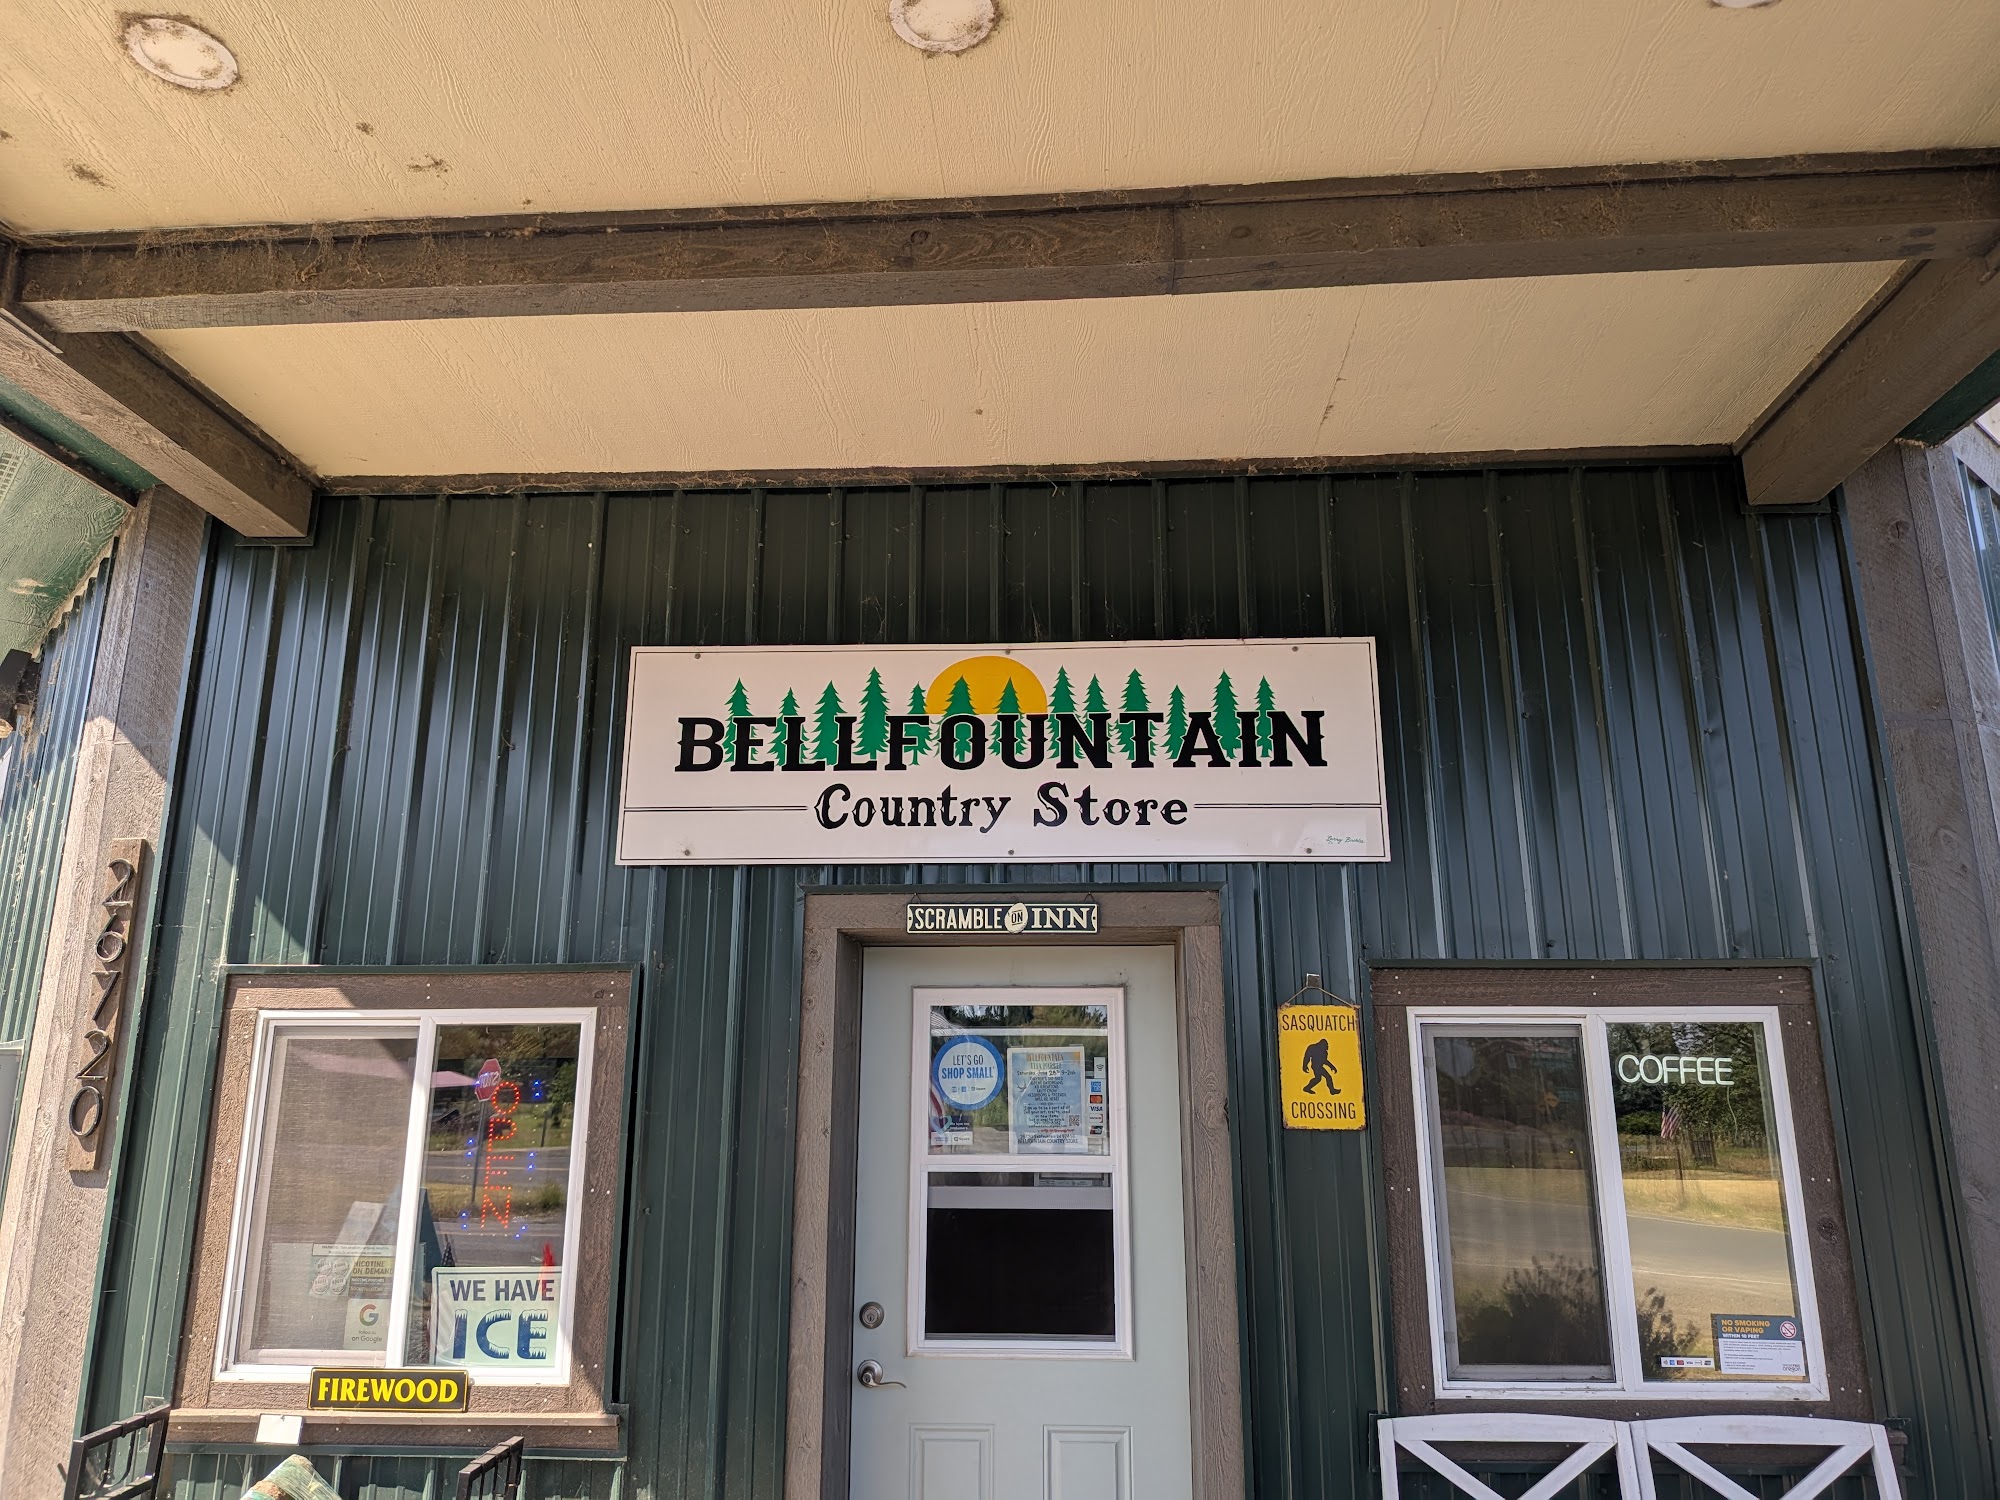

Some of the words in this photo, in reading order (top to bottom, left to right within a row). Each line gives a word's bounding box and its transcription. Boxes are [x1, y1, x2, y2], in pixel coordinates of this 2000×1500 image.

[674, 709, 1329, 773] BELLFOUNTAIN
[814, 782, 1011, 834] Country
[1032, 780, 1190, 828] Store
[914, 907, 1003, 930] SCRAMBLE
[1011, 910, 1023, 924] ON
[1031, 907, 1091, 929] INN
[68, 857, 133, 1138] 26720
[1282, 1014, 1356, 1032] SASQUATCH
[942, 1067, 964, 1079] SHOP
[966, 1067, 993, 1079] SMALL
[953, 1054, 972, 1066] LET'S
[973, 1054, 984, 1065] GO
[1618, 1054, 1734, 1086] COFFEE
[1291, 1102, 1356, 1120] CROSSING
[480, 1080, 521, 1229] OPEN
[450, 1280, 486, 1301] WE
[495, 1280, 554, 1301] HAVE
[453, 1309, 548, 1359] ICE
[318, 1377, 458, 1403] FIREWOOD
